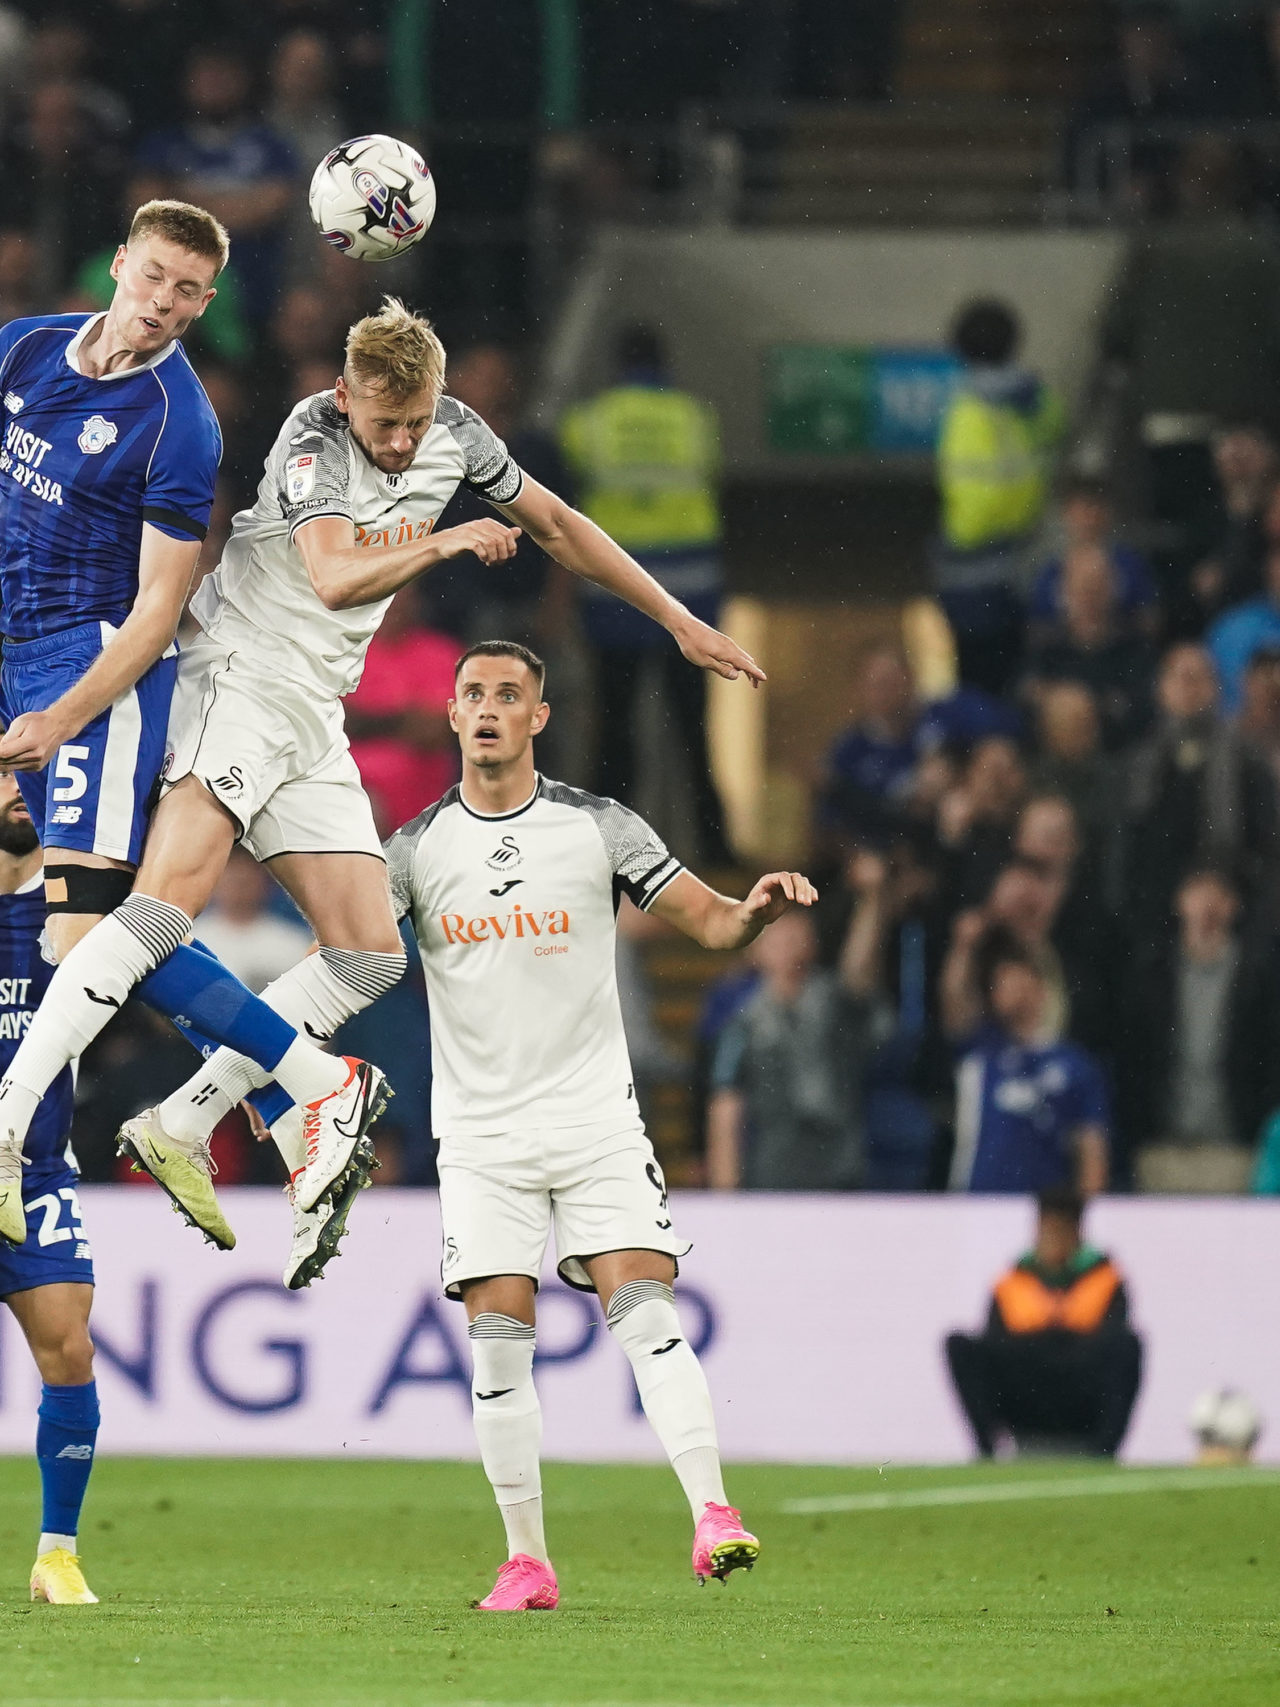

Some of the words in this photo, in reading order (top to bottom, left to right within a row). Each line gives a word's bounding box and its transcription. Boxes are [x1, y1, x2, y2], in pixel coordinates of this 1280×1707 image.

[6, 422, 53, 469] VISIT
[53, 745, 90, 801] 5
[441, 904, 569, 945] Reviva
[534, 945, 569, 957] Coffee
[23, 1187, 89, 1248] 23
